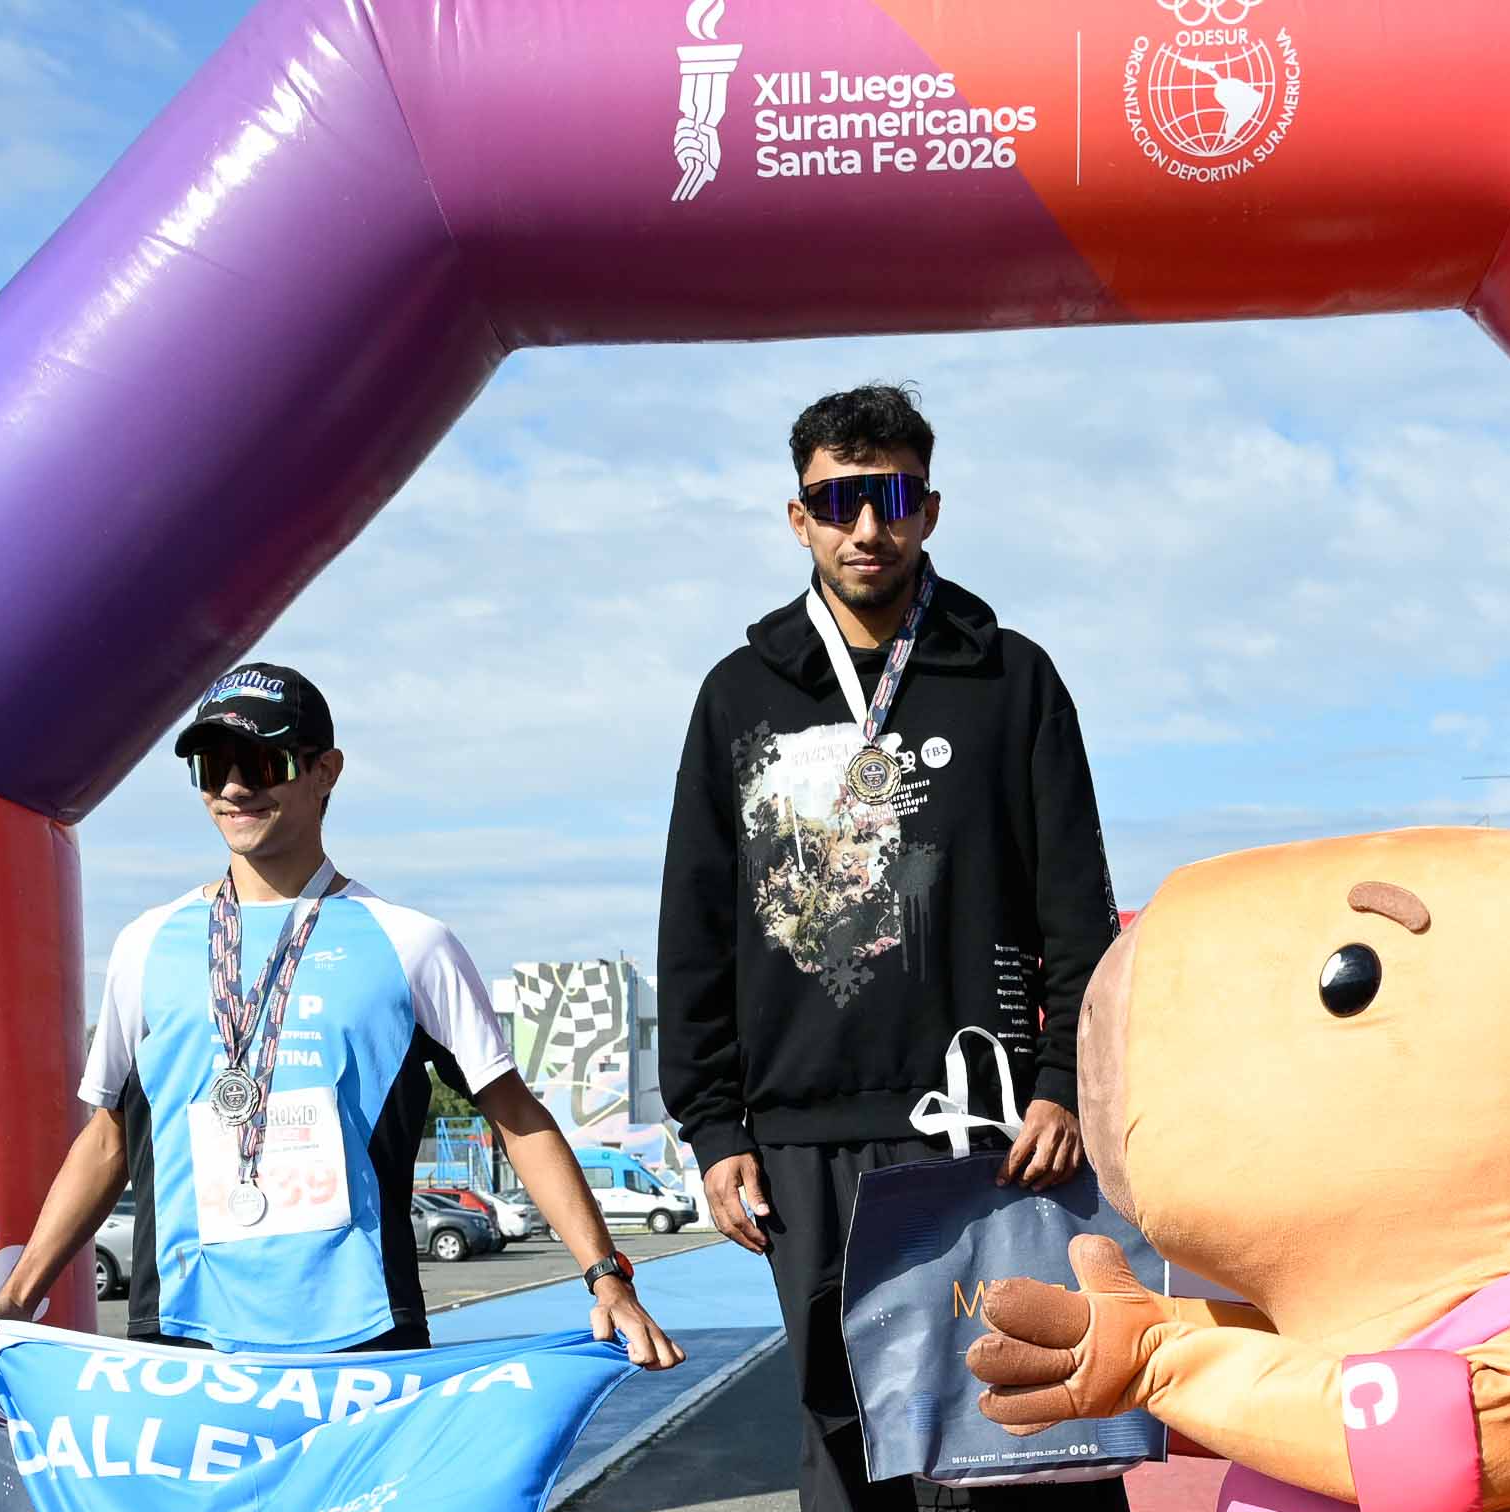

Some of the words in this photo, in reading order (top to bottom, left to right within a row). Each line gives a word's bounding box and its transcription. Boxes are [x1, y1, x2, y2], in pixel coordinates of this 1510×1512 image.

[1175, 28, 1249, 47] ODESUR
[754, 71, 812, 107] XIII
[819, 69, 955, 109] Juegos
[1167, 157, 1255, 183] DEPORTIVA
[1253, 27, 1301, 163] SURAMERICANA
[754, 102, 1037, 143] Suramericanos
[755, 141, 866, 178] Santa
[873, 139, 917, 175] Fe
[924, 136, 1017, 171] 2026
[924, 744, 949, 759] TBS
